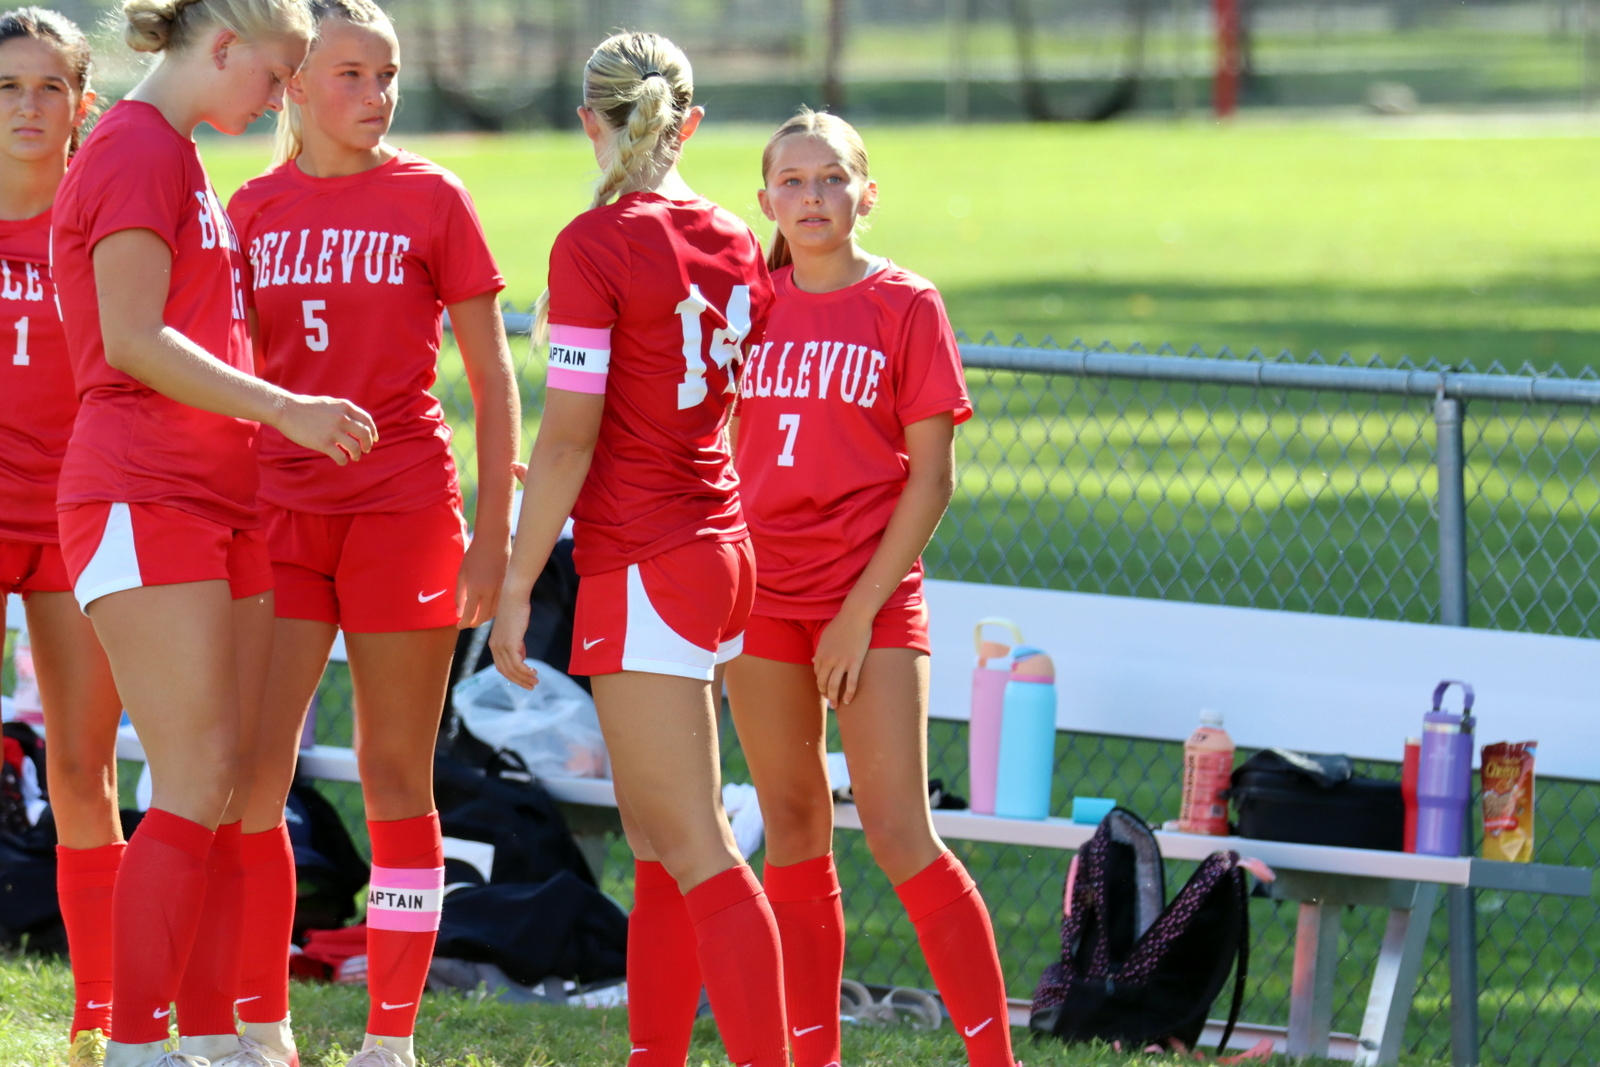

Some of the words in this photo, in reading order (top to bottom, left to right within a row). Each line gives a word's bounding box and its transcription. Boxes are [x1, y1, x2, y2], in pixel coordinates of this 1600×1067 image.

[249, 228, 411, 291] BELLEVUE
[13, 316, 30, 366] 1
[302, 300, 329, 351] 5
[549, 347, 586, 366] APTAIN
[740, 341, 886, 408] ELLEVUE
[777, 414, 800, 467] 7
[368, 891, 423, 909] APTAIN
